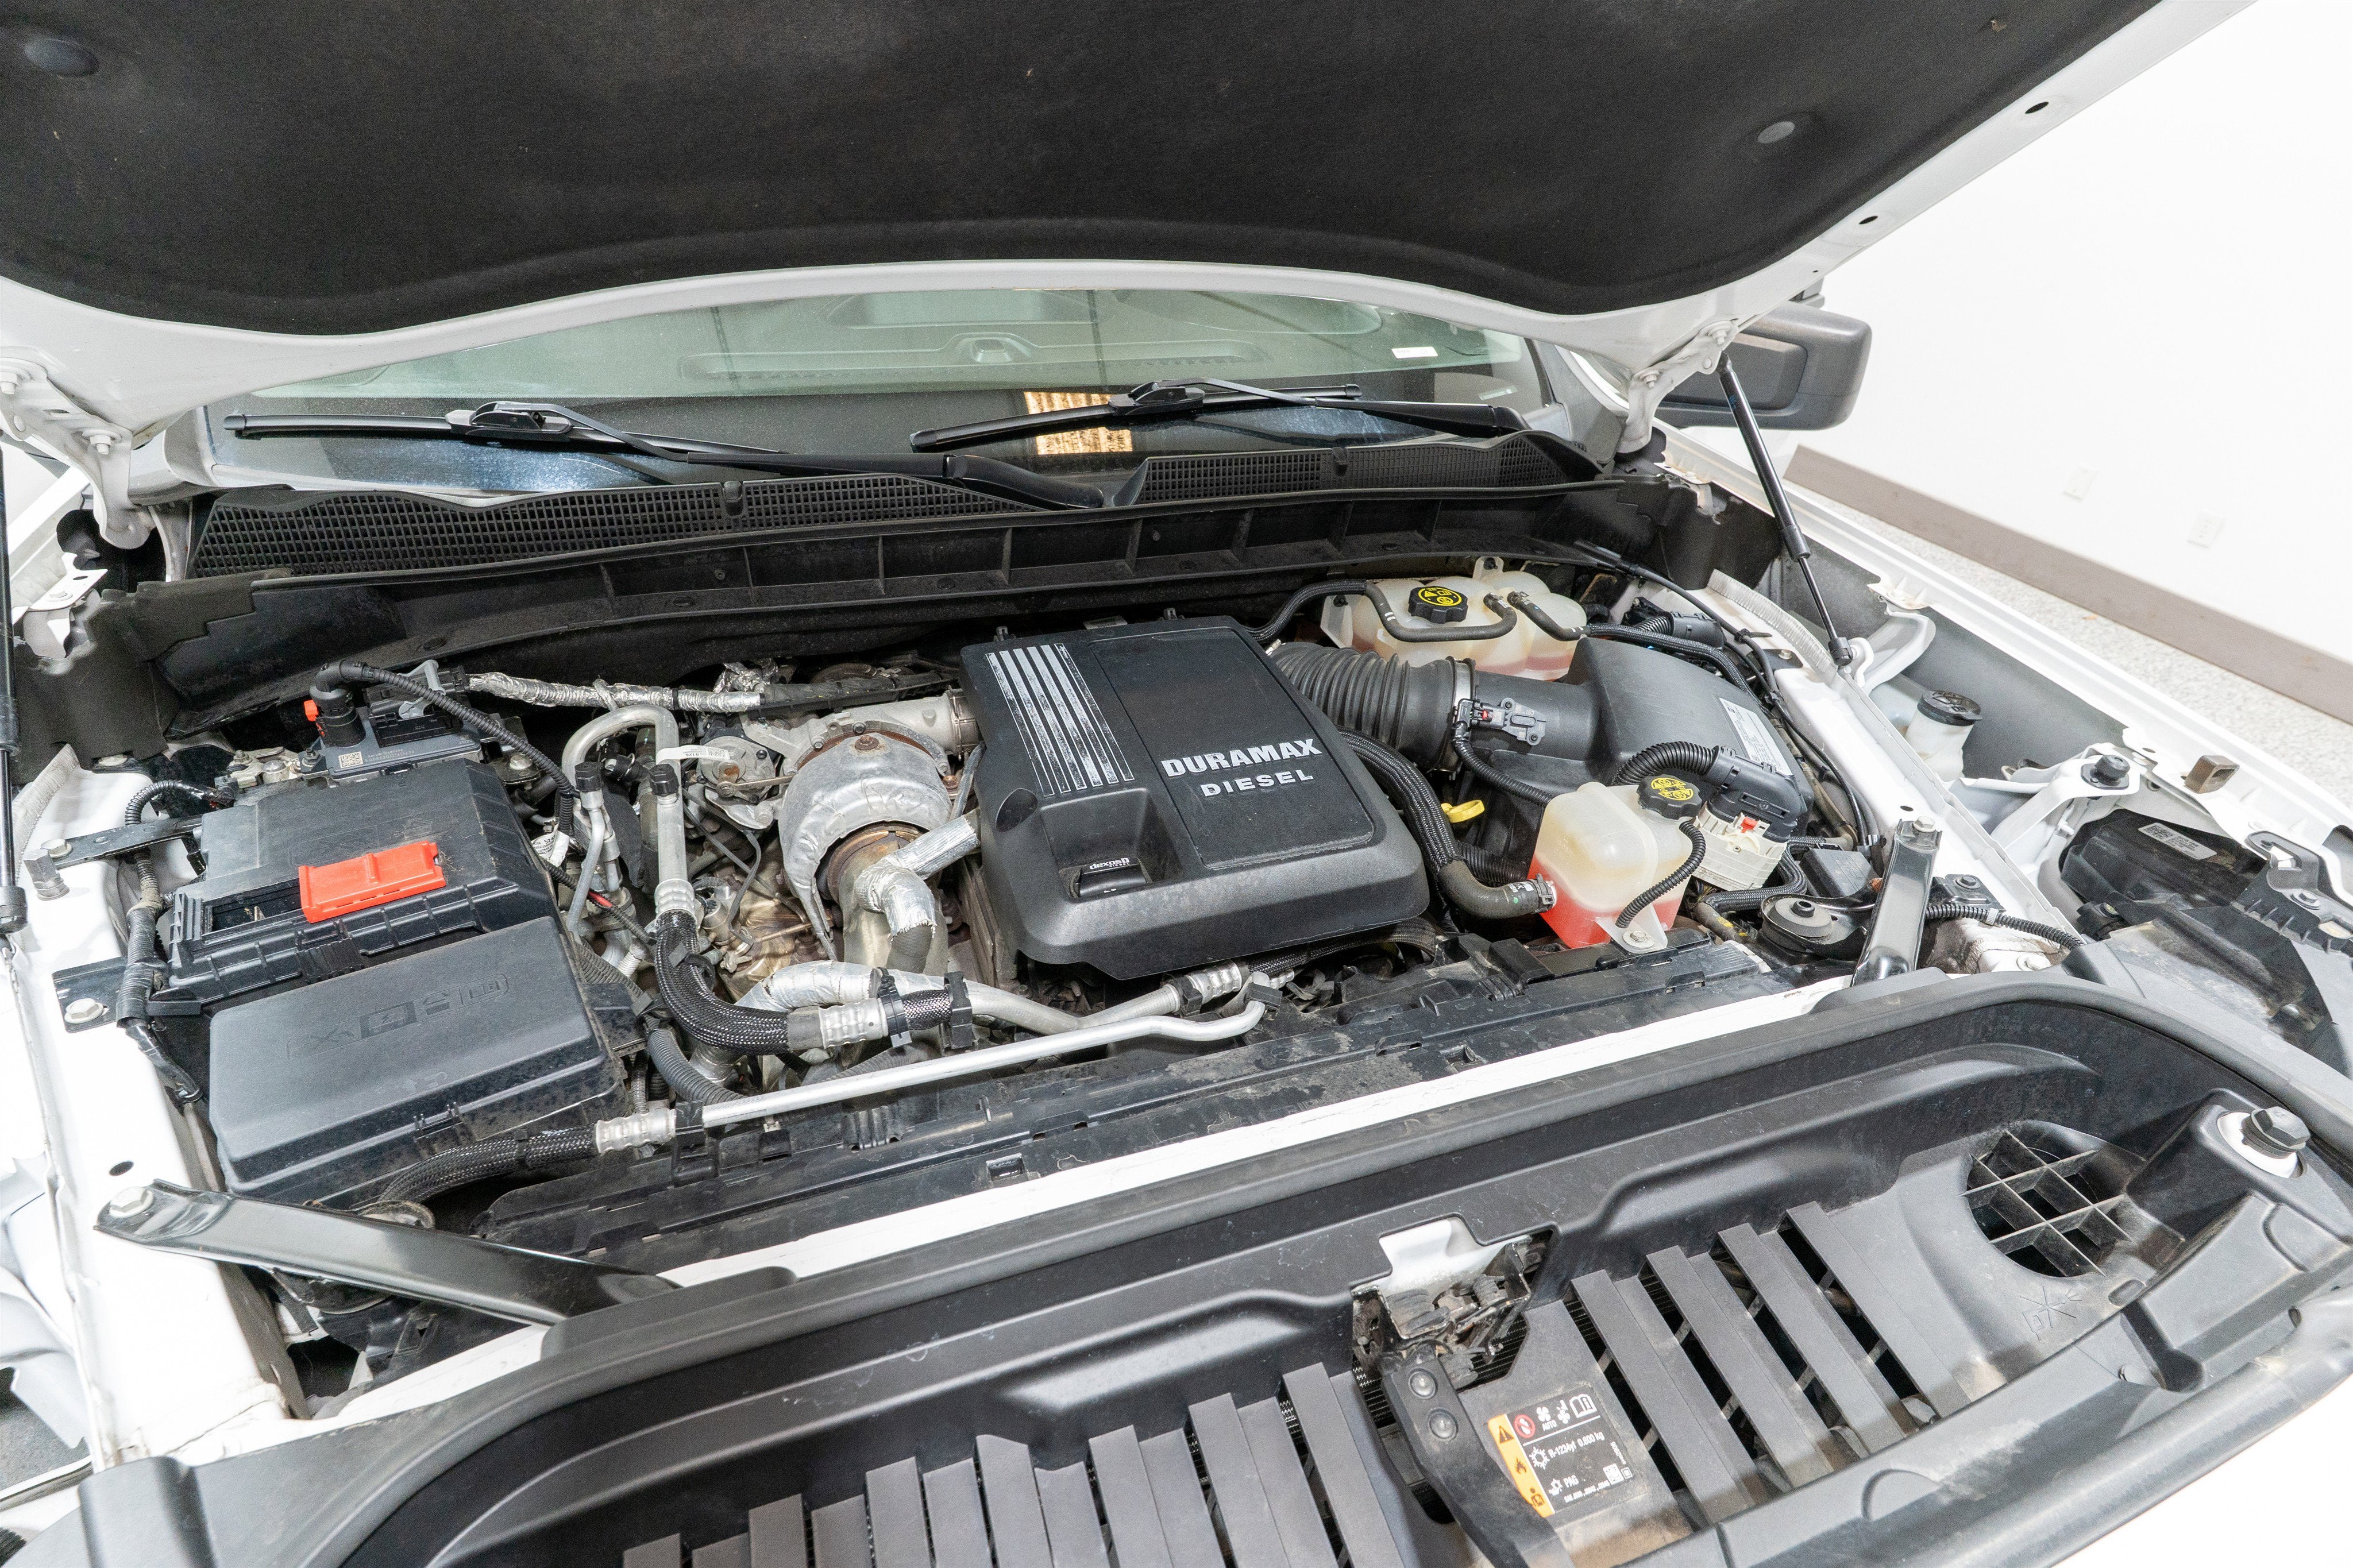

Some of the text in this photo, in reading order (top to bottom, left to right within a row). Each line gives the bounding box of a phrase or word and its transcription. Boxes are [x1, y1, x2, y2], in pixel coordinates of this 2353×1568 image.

[1161, 739, 1322, 777] DURAMAX
[1200, 769, 1314, 797] DIESEL
[1542, 1420, 1557, 1431] AUTO
[1594, 1431, 1605, 1440] kg
[1563, 1474, 1579, 1488] PAG
